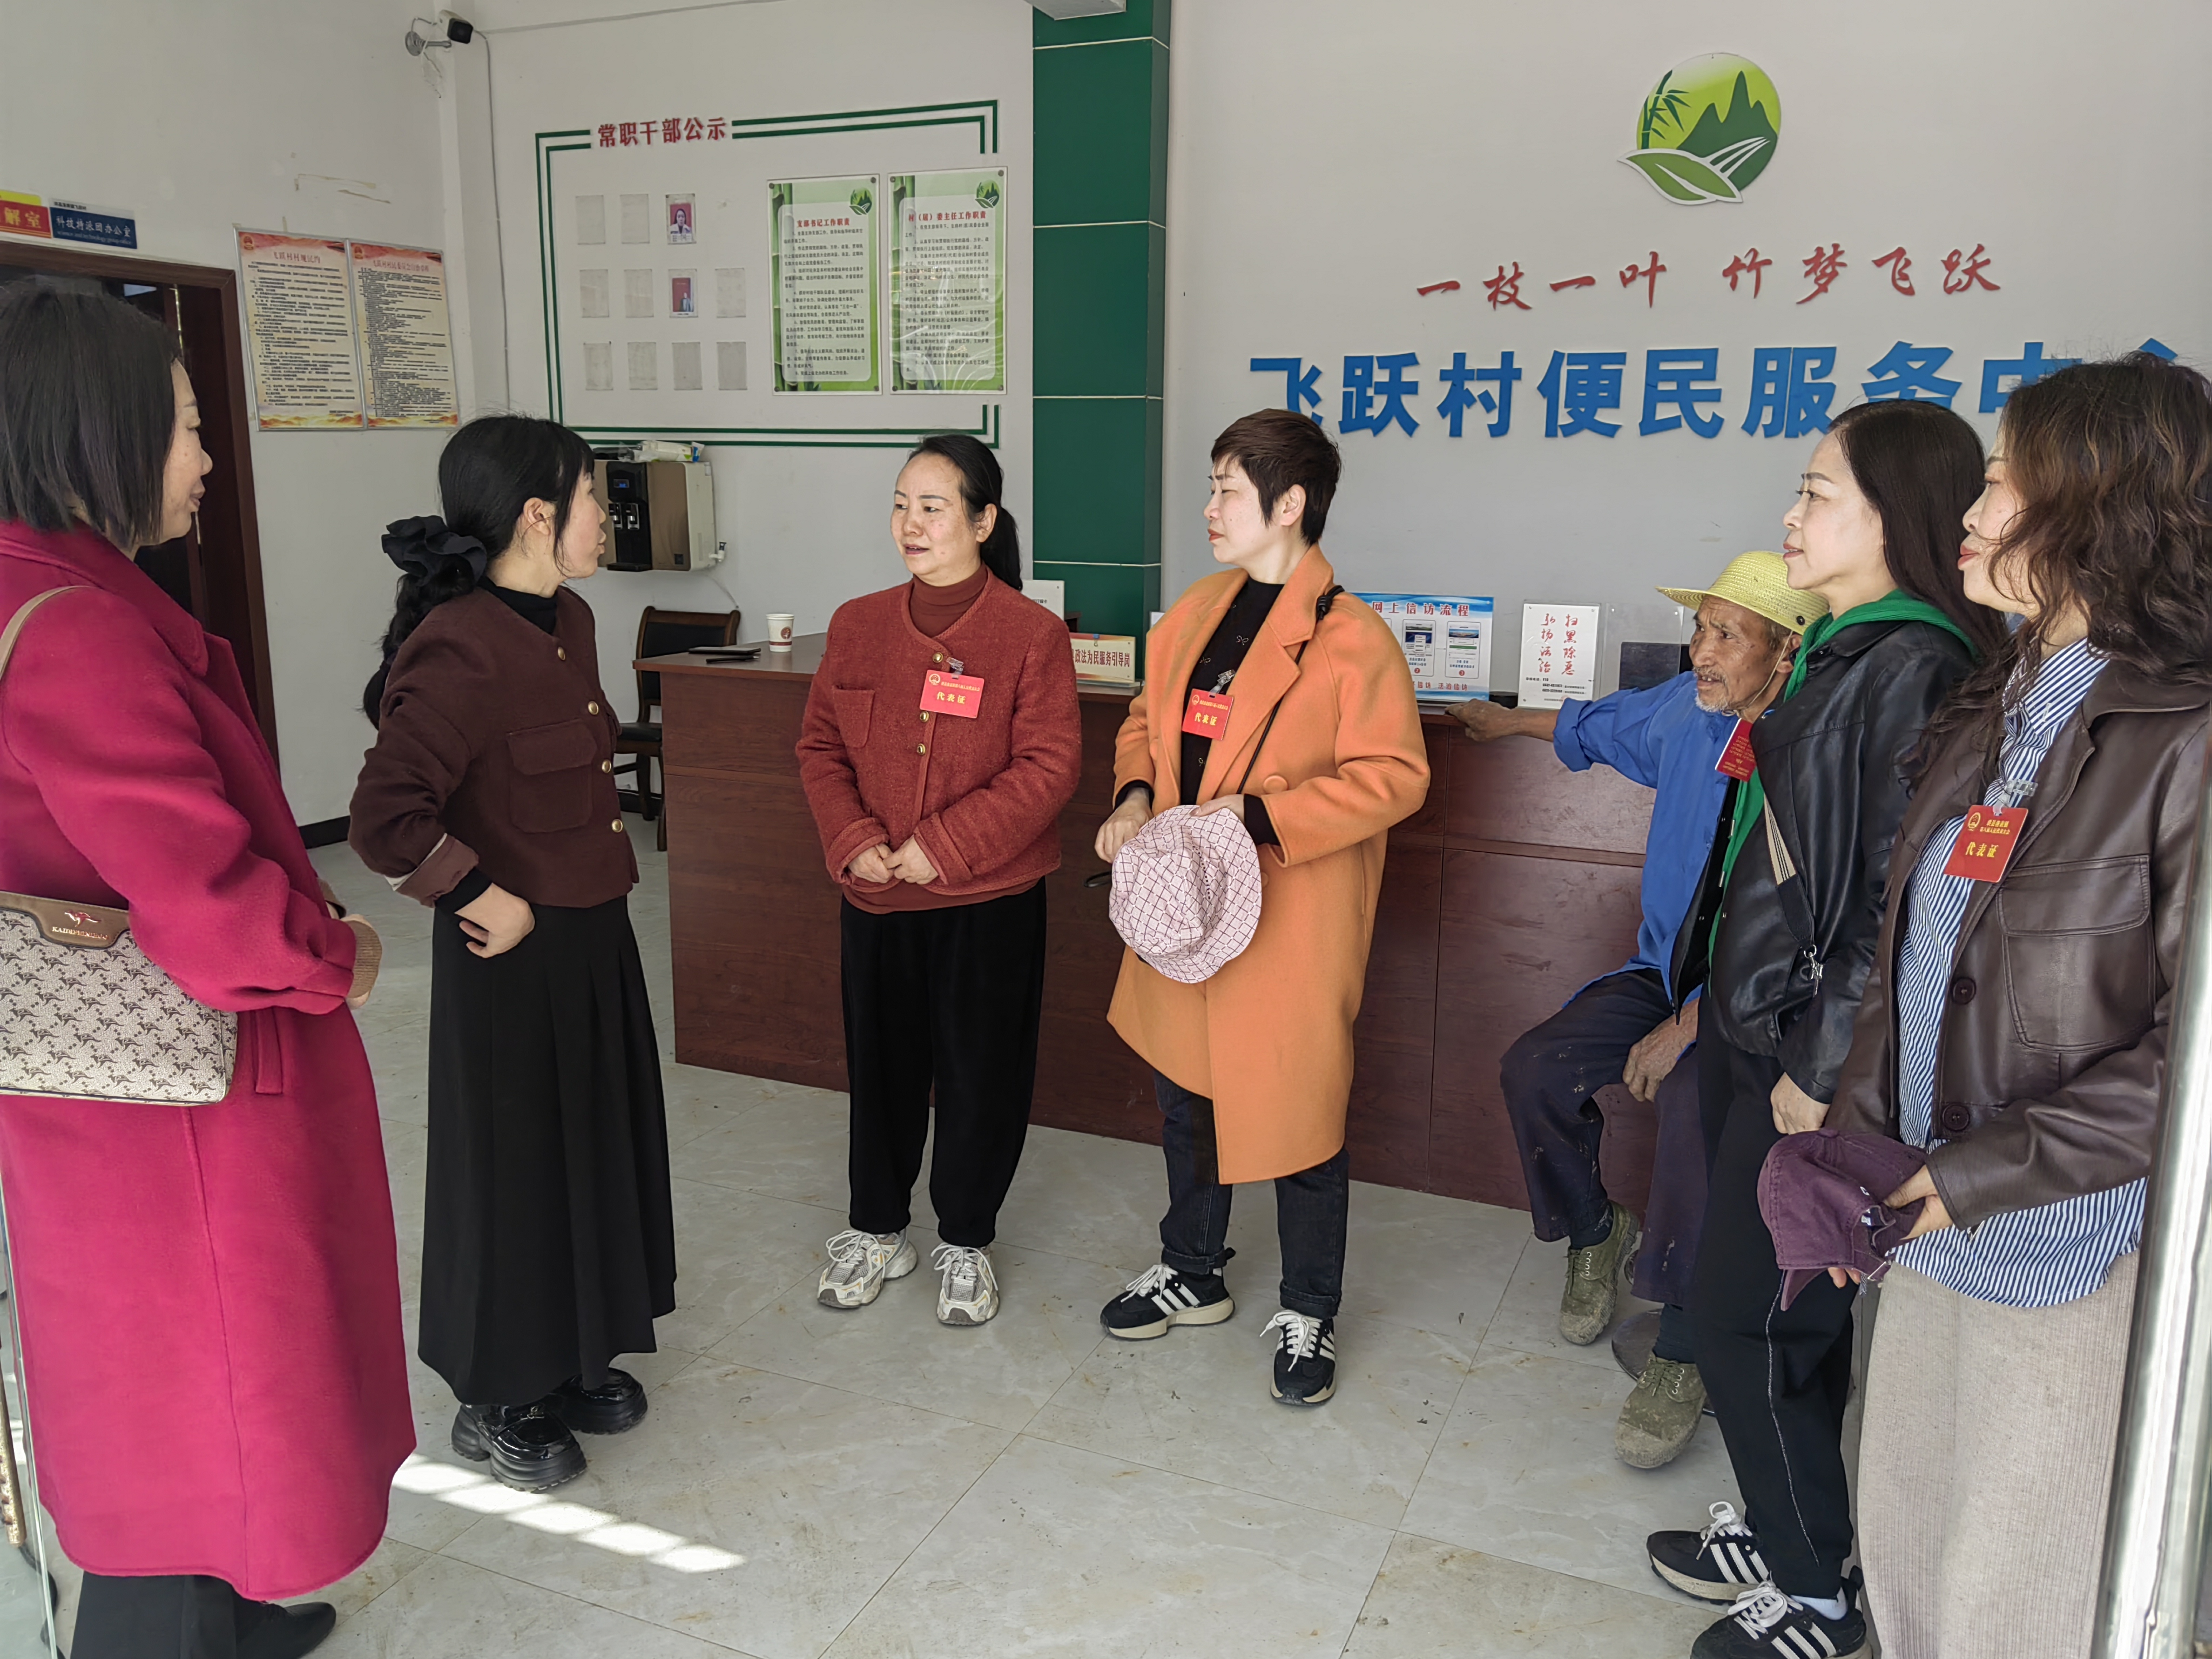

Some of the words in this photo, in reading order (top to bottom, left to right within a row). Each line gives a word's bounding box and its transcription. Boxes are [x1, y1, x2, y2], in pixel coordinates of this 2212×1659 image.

[598, 117, 727, 147] 常职干部公示
[797, 218, 850, 227] 支部书记工作职责
[908, 211, 987, 222] 村（居）委主任工作职责
[56, 215, 131, 237] 科技特派团办公室
[1417, 251, 1667, 311] 一枝一叶
[1722, 243, 2001, 305] 竹梦飞跃
[1372, 602, 1469, 617] 网上信访流程
[1539, 613, 1556, 673] 弘扬法治
[1561, 613, 1579, 676] 扫黑除恶
[1438, 683, 1468, 691] 法治信访
[936, 691, 966, 704] 代表证
[1195, 712, 1218, 726] 代表证
[1965, 841, 1999, 858] 代表证
